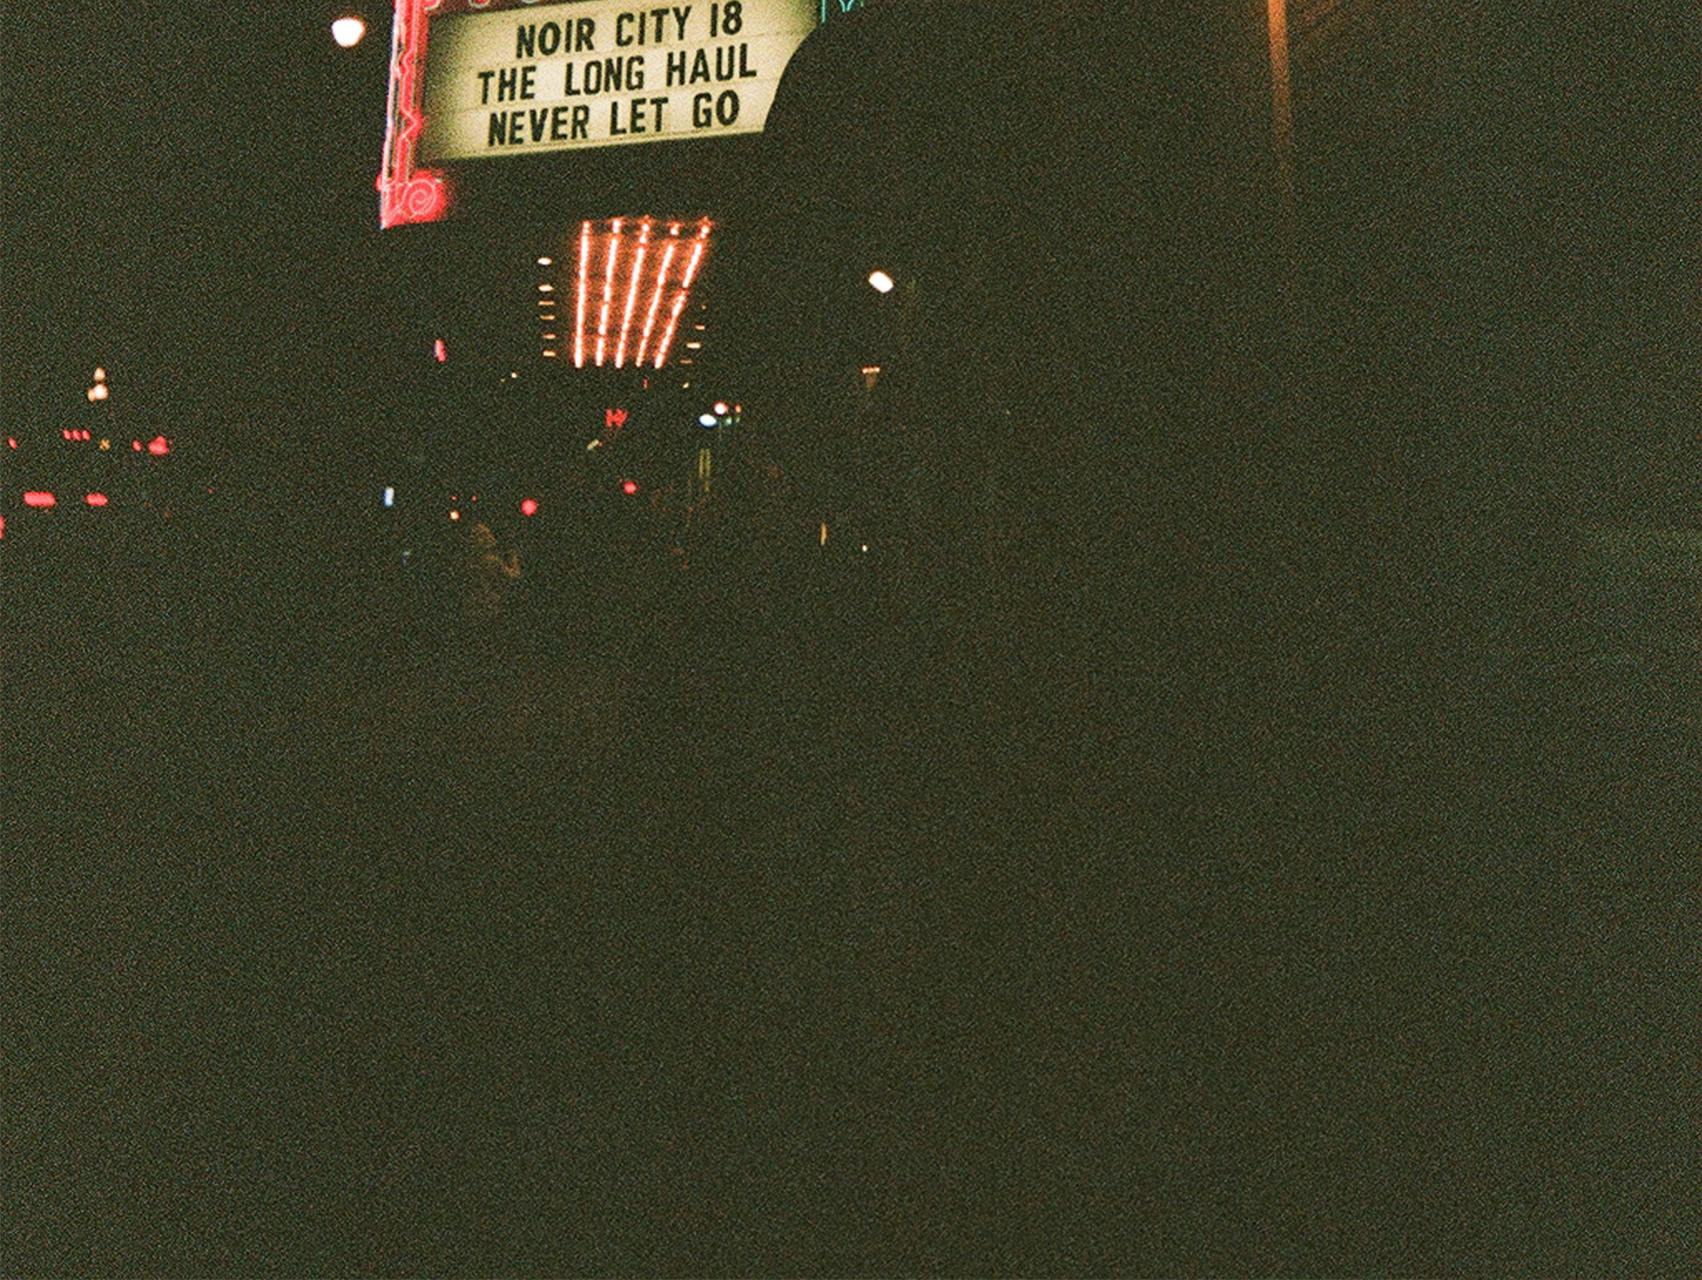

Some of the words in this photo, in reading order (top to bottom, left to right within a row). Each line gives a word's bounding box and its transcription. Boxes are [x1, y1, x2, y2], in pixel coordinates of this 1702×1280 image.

[516, 18, 596, 58] NOIR
[615, 5, 692, 47] CITY
[710, 0, 743, 37] 18
[477, 66, 537, 105] THE
[564, 55, 645, 96] LONG
[666, 43, 757, 87] HAUL
[488, 104, 591, 146] NEVER
[609, 97, 669, 136] LET
[692, 89, 740, 129] GO
